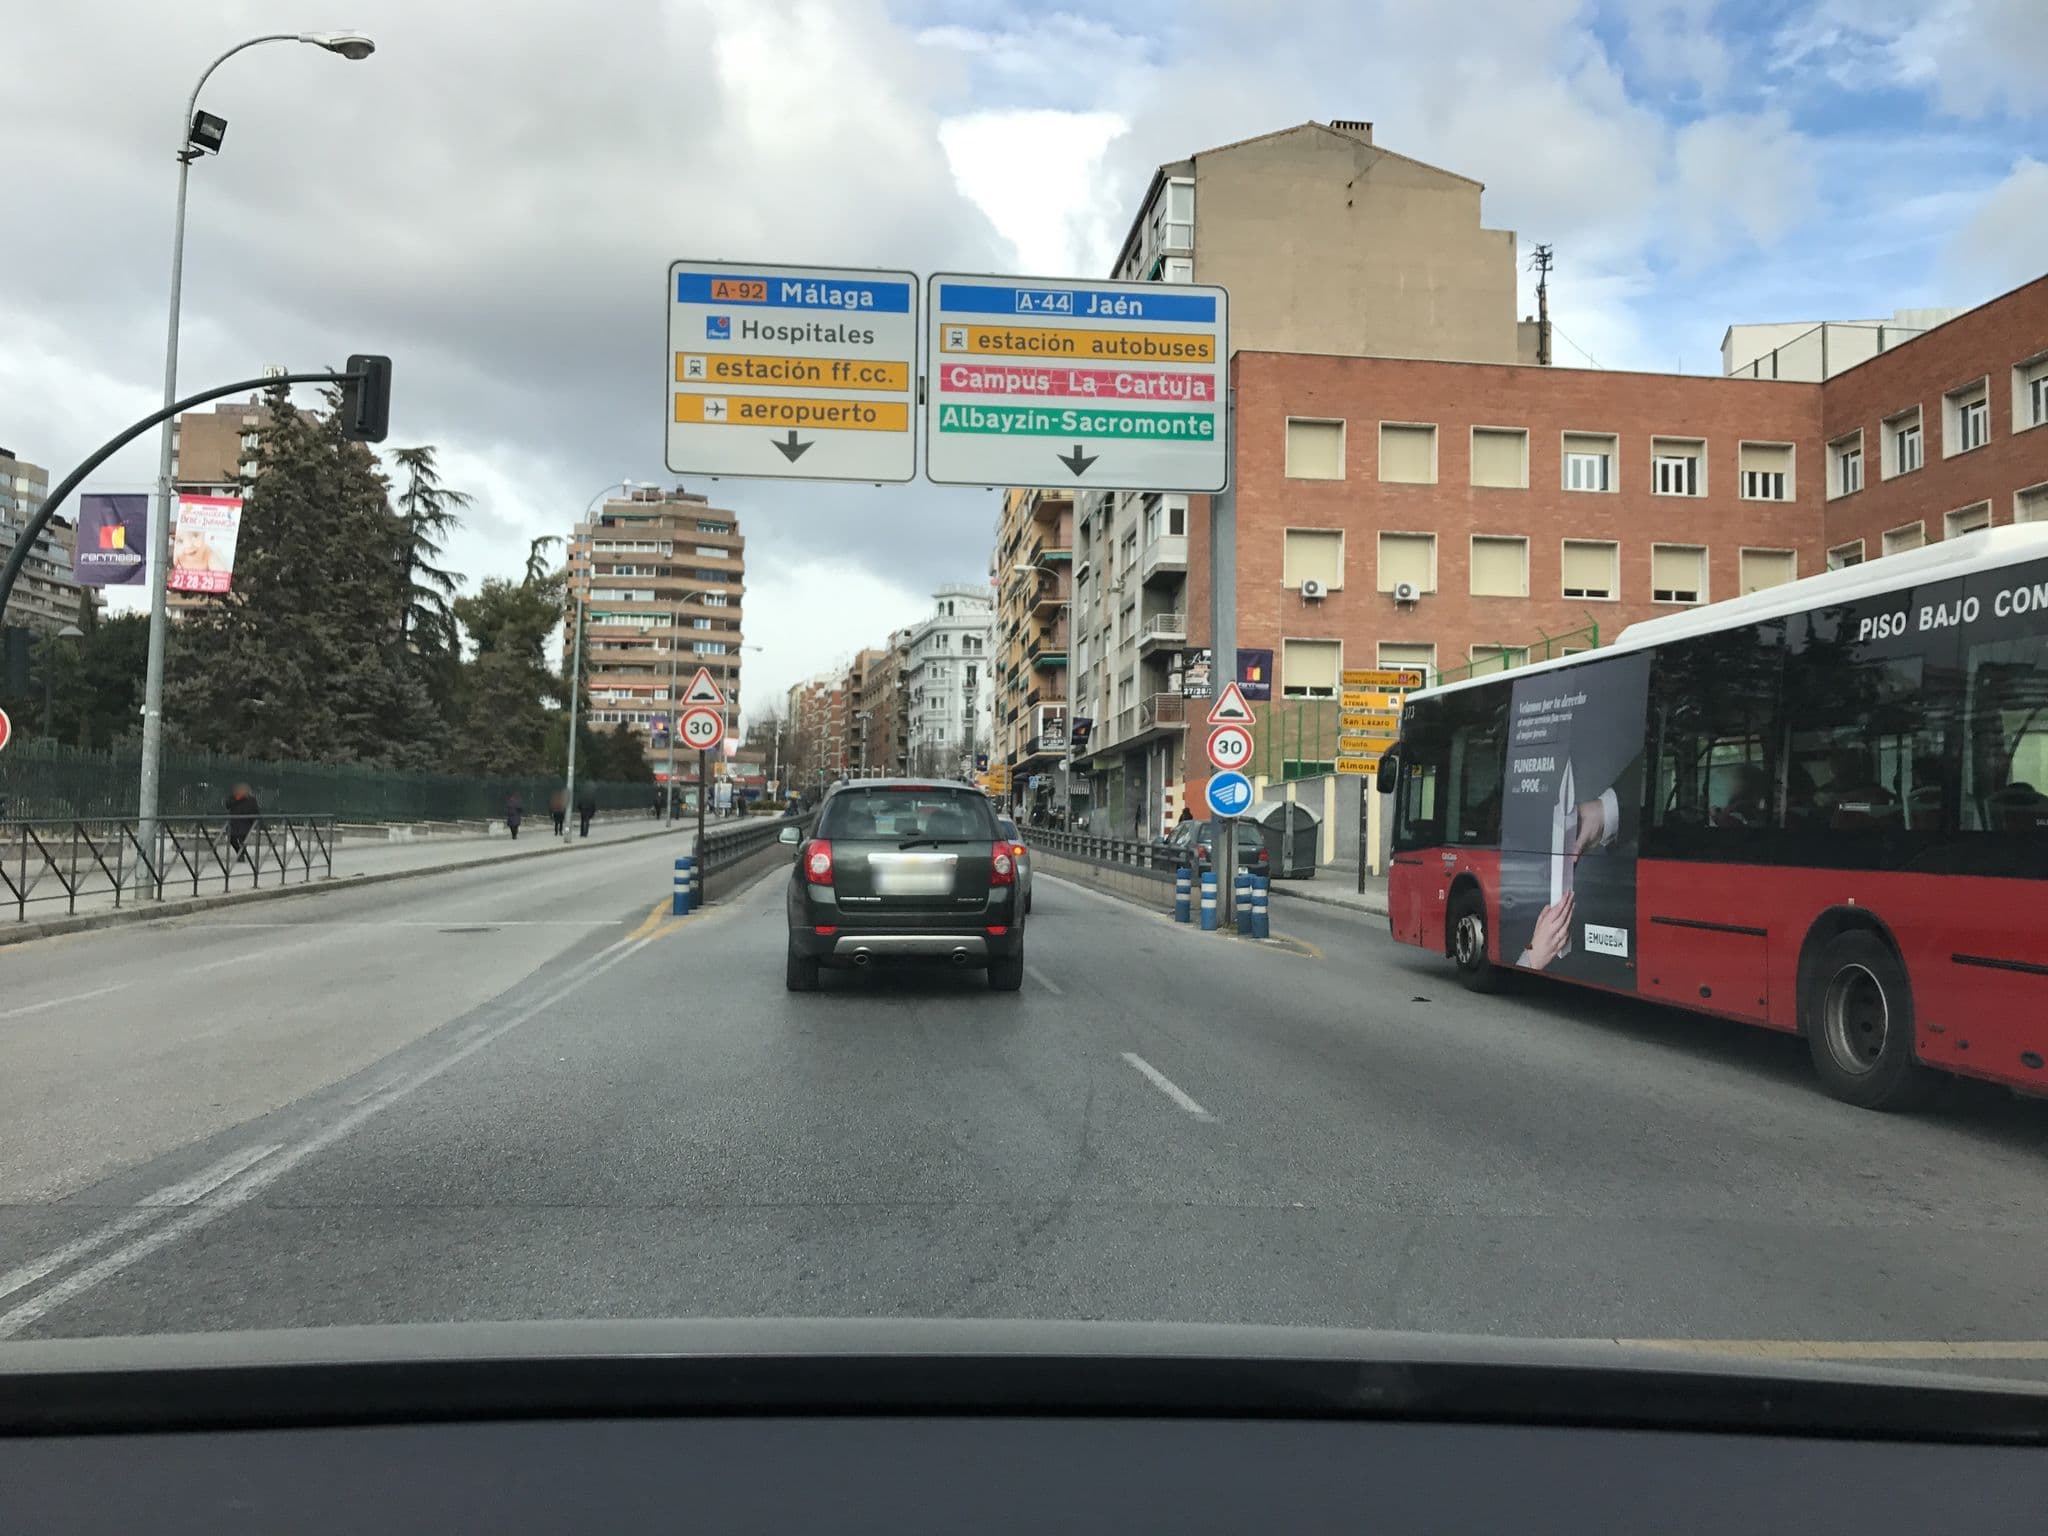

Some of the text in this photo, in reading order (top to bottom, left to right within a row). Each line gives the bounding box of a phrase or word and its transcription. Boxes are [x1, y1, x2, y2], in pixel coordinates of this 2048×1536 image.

[715, 282, 874, 309] A-92 Málaga
[1019, 293, 1143, 316] A-44 Jaén
[742, 320, 875, 344] Hospitales
[978, 333, 1209, 357] estación autobuses
[716, 359, 893, 383] estación ff.cc.
[950, 367, 1206, 400] Campus La Cartuja
[740, 402, 877, 423] aeropuerto
[942, 406, 1213, 436] Albayzín-Sacromonte
[1858, 582, 2048, 642] PISO BAJO CON
[689, 721, 713, 735] 30
[1343, 717, 1359, 727] San
[1218, 740, 1242, 755] 30
[1339, 761, 1376, 770] Almona
[1513, 756, 1555, 773] FUNERARIA
